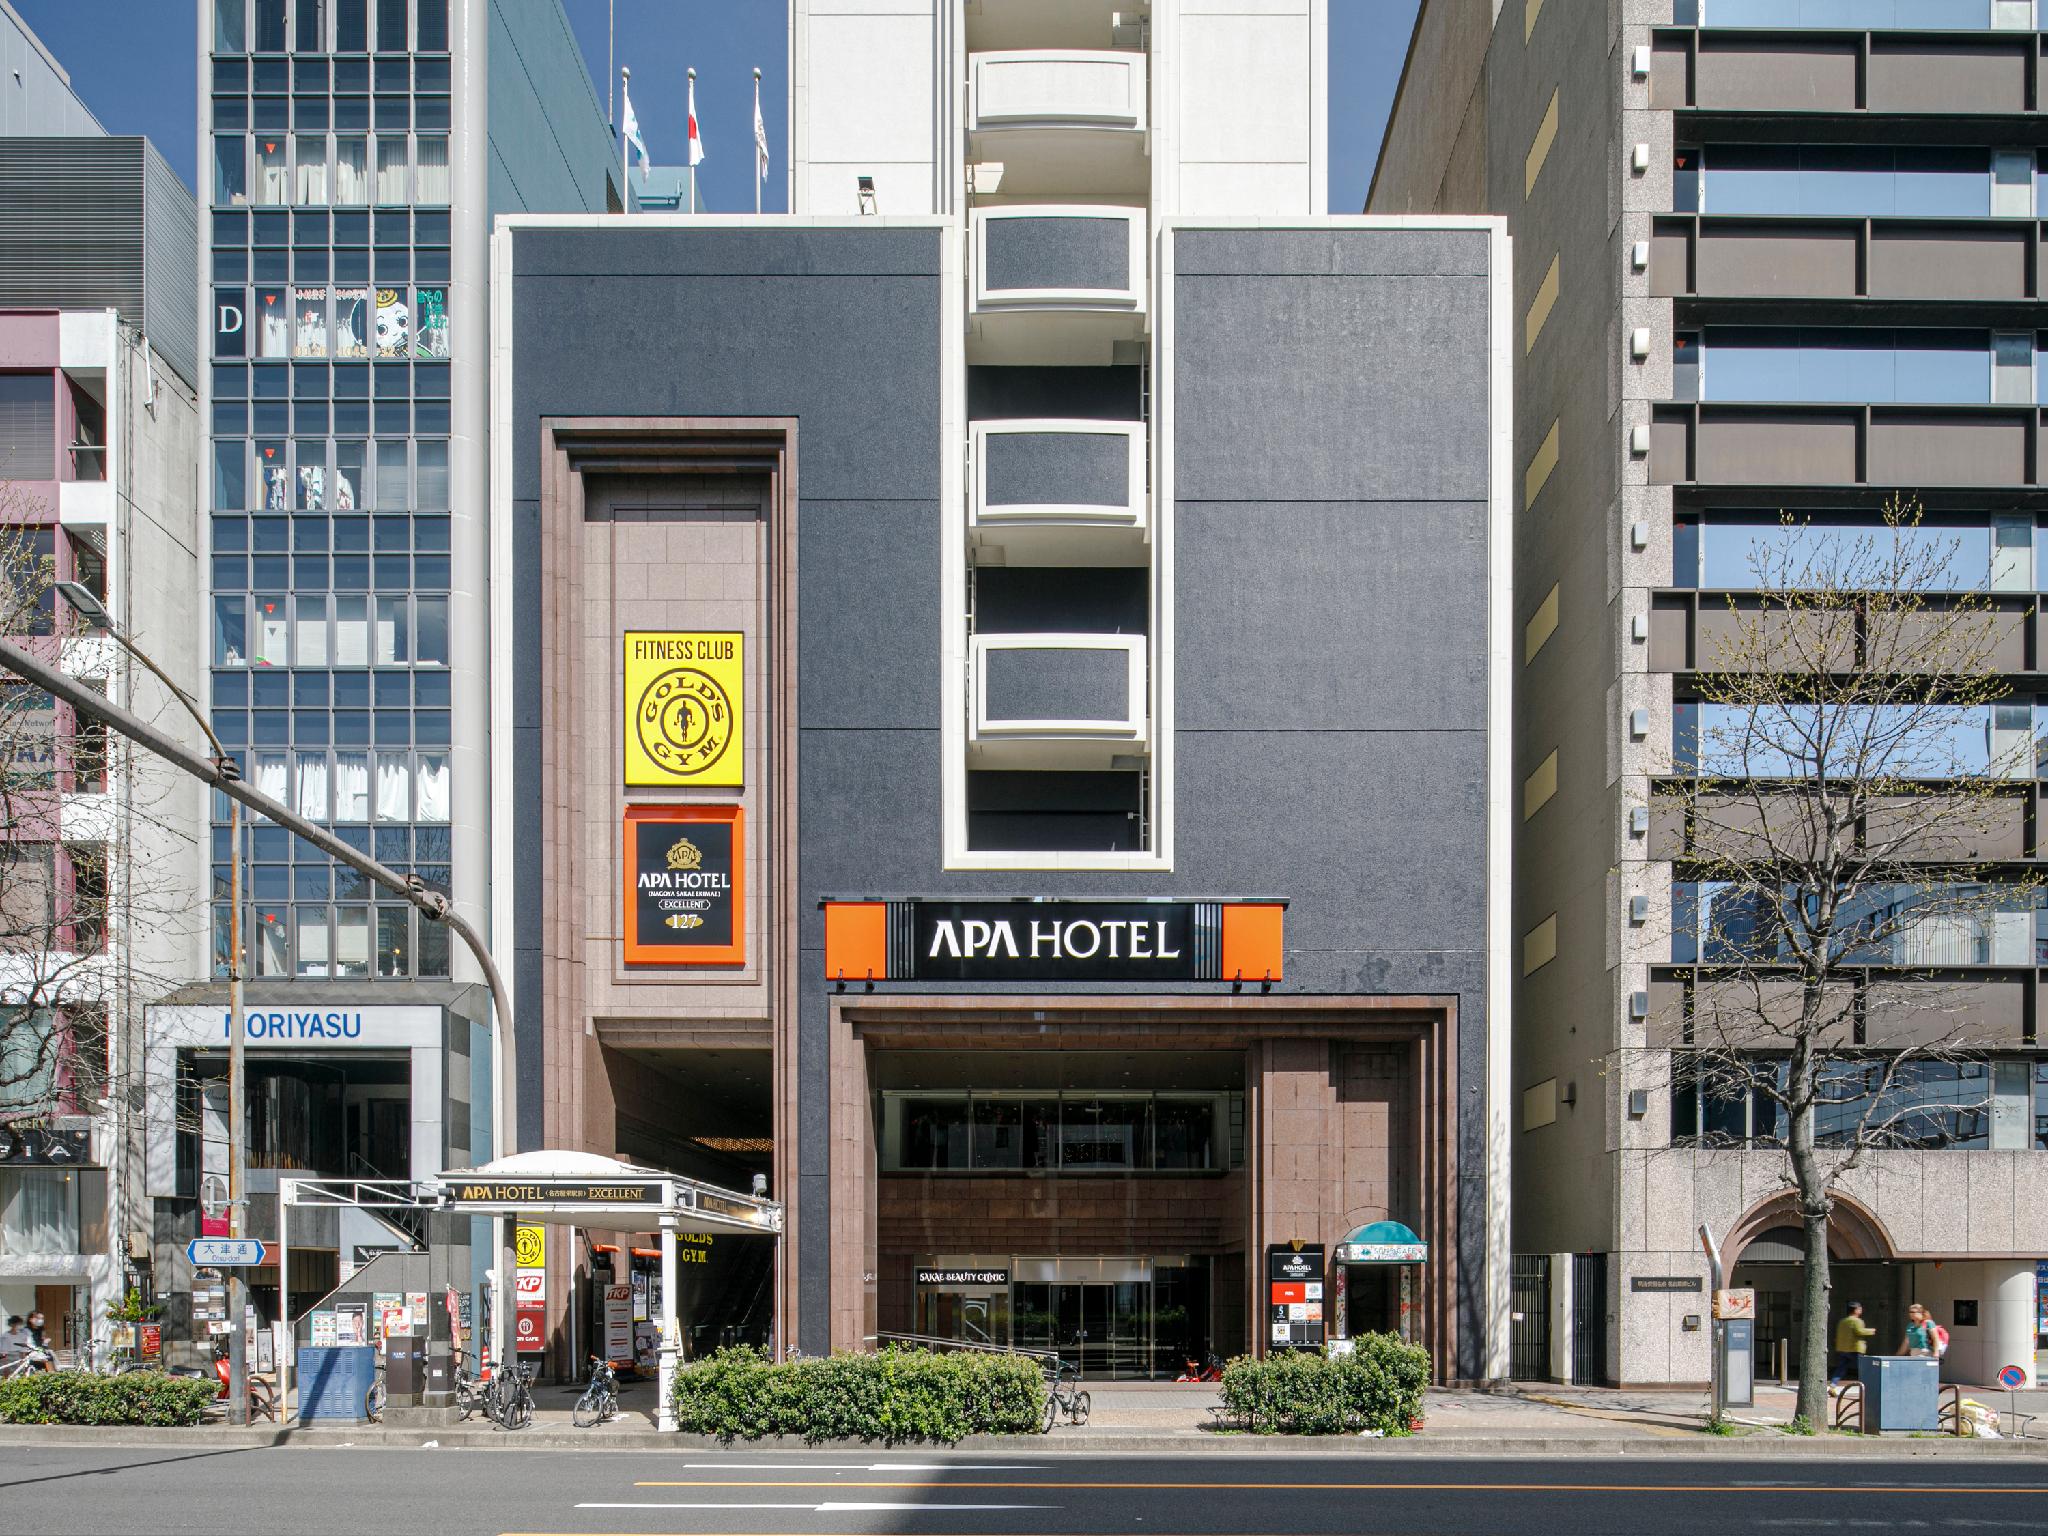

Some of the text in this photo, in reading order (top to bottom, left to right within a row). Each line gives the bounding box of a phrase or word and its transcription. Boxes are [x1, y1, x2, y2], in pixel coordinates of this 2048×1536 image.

[218, 305, 243, 333] D
[635, 640, 734, 660] FITNESS CLUB
[645, 677, 724, 722] GOLD'S
[653, 736, 720, 765] GYM
[673, 850, 695, 860] APA
[637, 873, 730, 888] APA HOTEL
[664, 900, 704, 909] EXCELLENT
[671, 914, 698, 929] 127
[929, 920, 1180, 958] APA HOTEL
[463, 1186, 492, 1199] APA
[495, 1186, 545, 1200] HOTEL
[588, 1188, 645, 1199] EXCELLENT
[202, 1243, 248, 1256] 大津通
[682, 1249, 707, 1263] GYM
[516, 1276, 541, 1290] KP
[920, 1272, 945, 1282] SAKAE
[945, 1272, 976, 1281] BEAUTY
[607, 1287, 629, 1299] TKP
